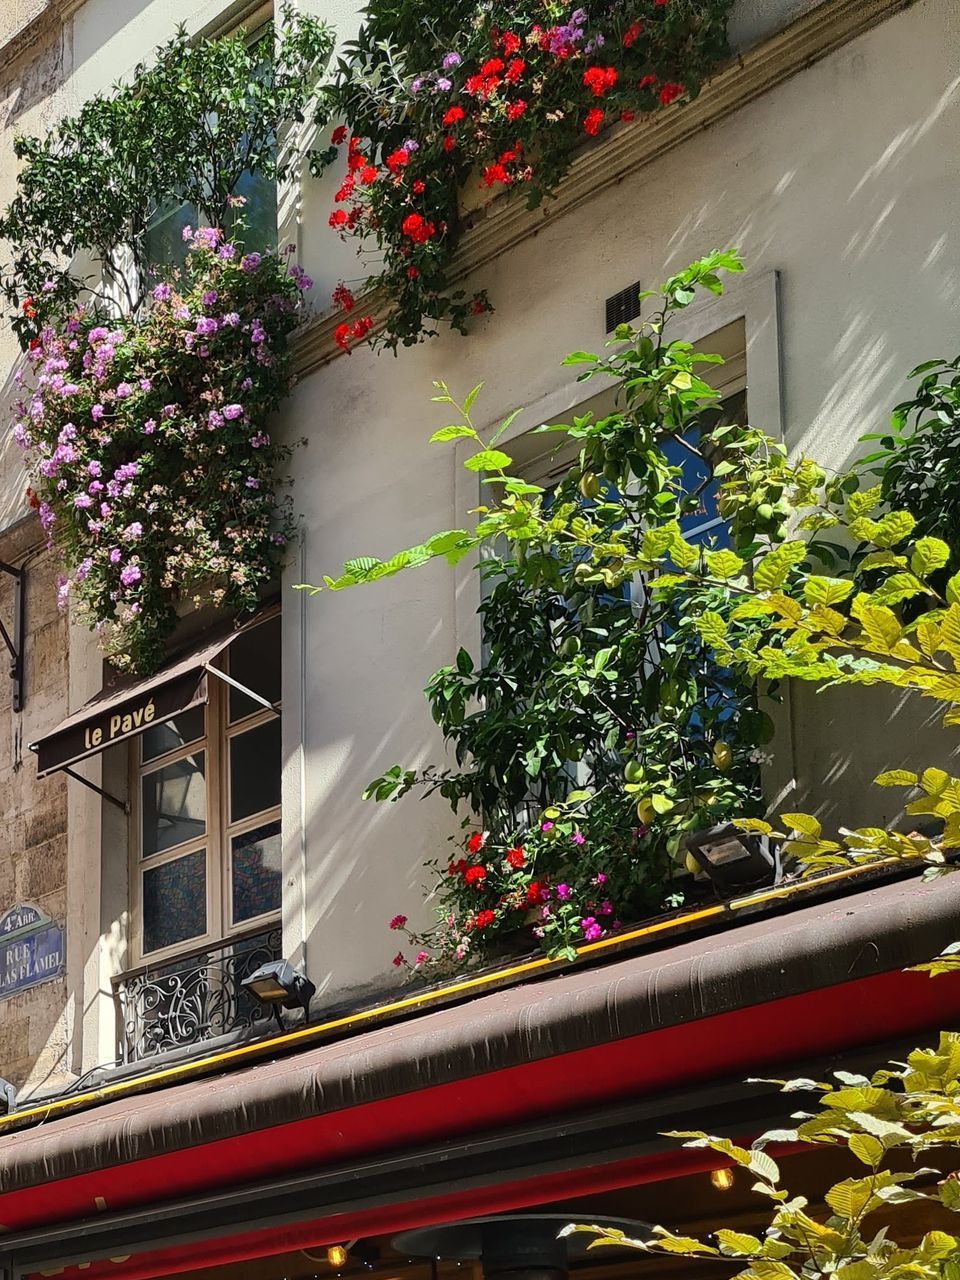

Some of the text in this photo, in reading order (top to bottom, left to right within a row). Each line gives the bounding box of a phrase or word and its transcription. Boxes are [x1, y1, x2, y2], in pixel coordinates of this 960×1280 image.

[84, 697, 155, 749] le Pavé
[6, 943, 30, 965] RUE
[19, 951, 63, 980] FLAMEL
